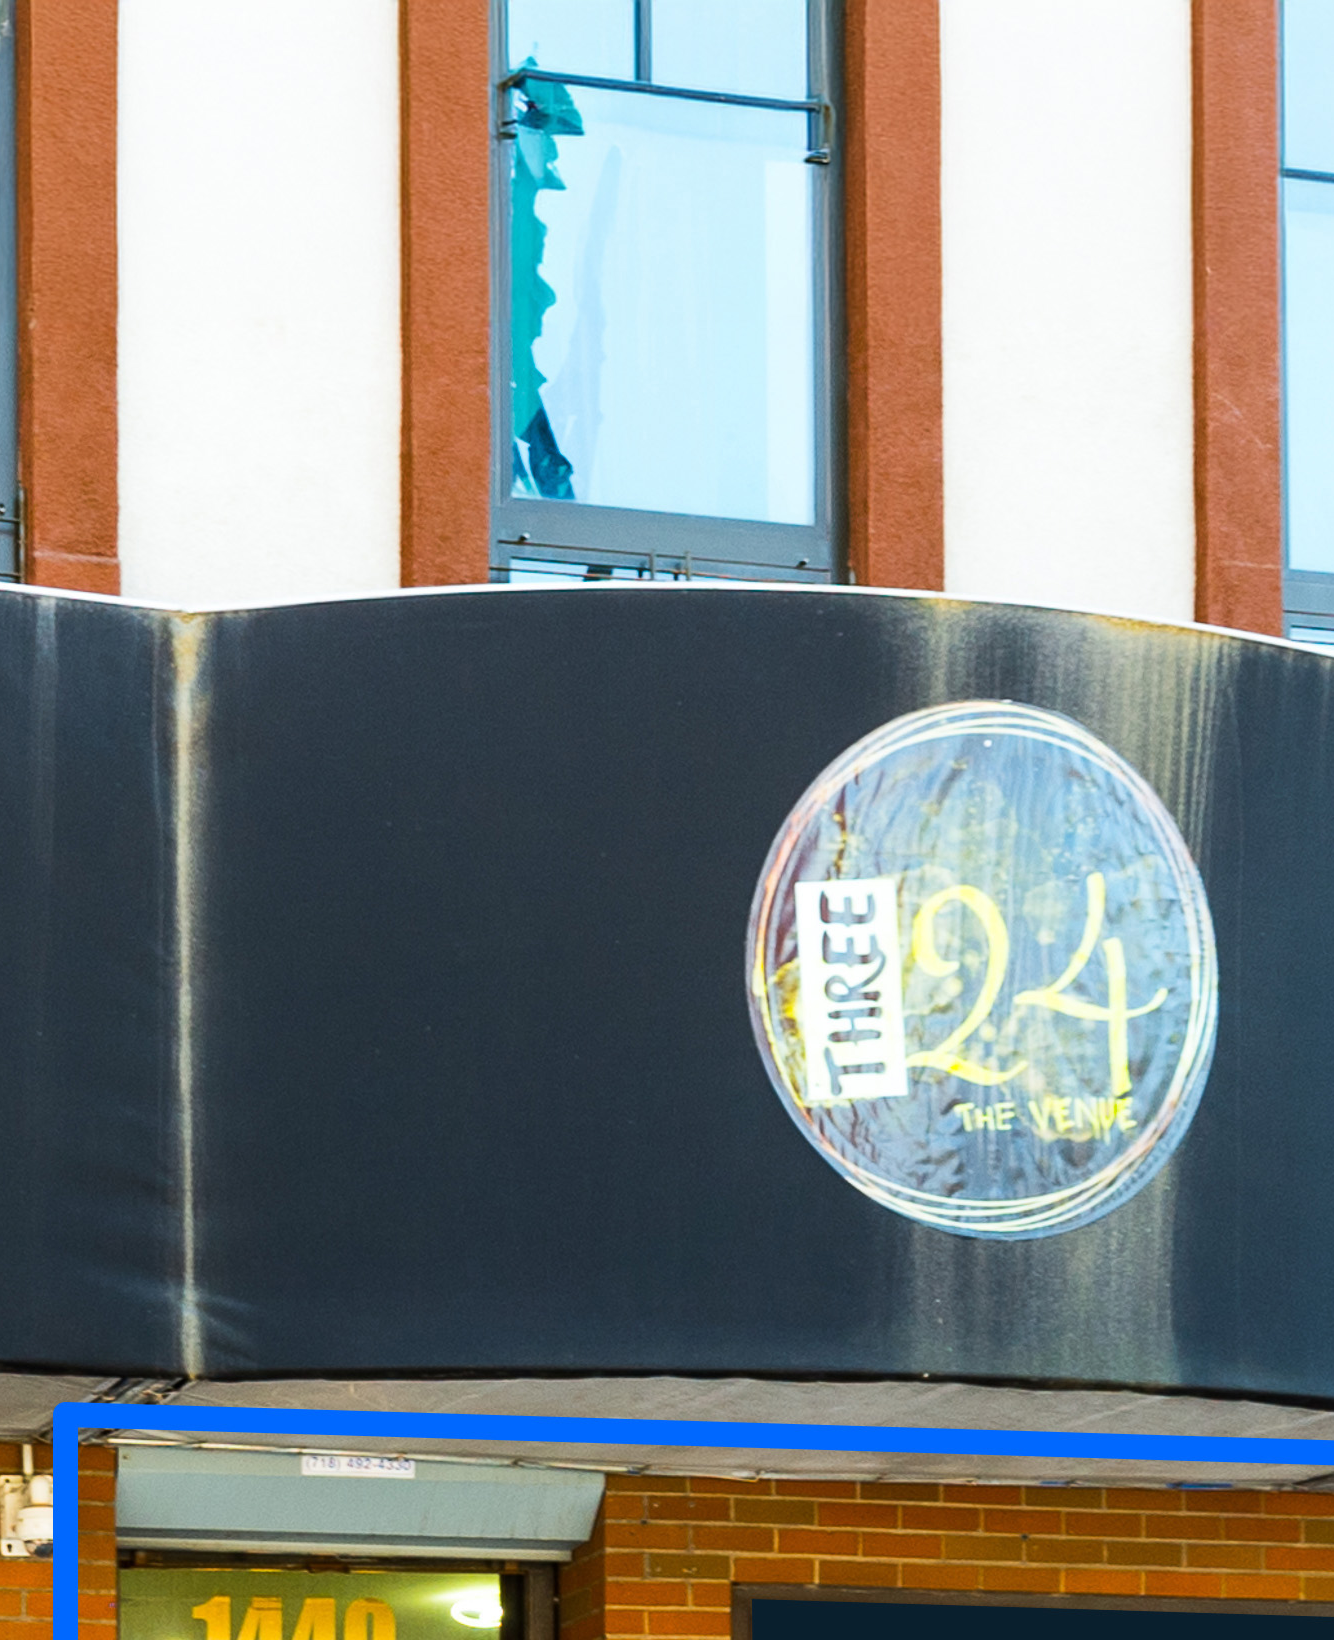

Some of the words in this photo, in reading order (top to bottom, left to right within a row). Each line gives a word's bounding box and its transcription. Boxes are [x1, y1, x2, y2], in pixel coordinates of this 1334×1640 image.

[818, 890, 887, 1097] THREE
[906, 872, 1168, 1098] 24
[954, 1101, 1016, 1132] THE
[1031, 1096, 1137, 1141] VENUE
